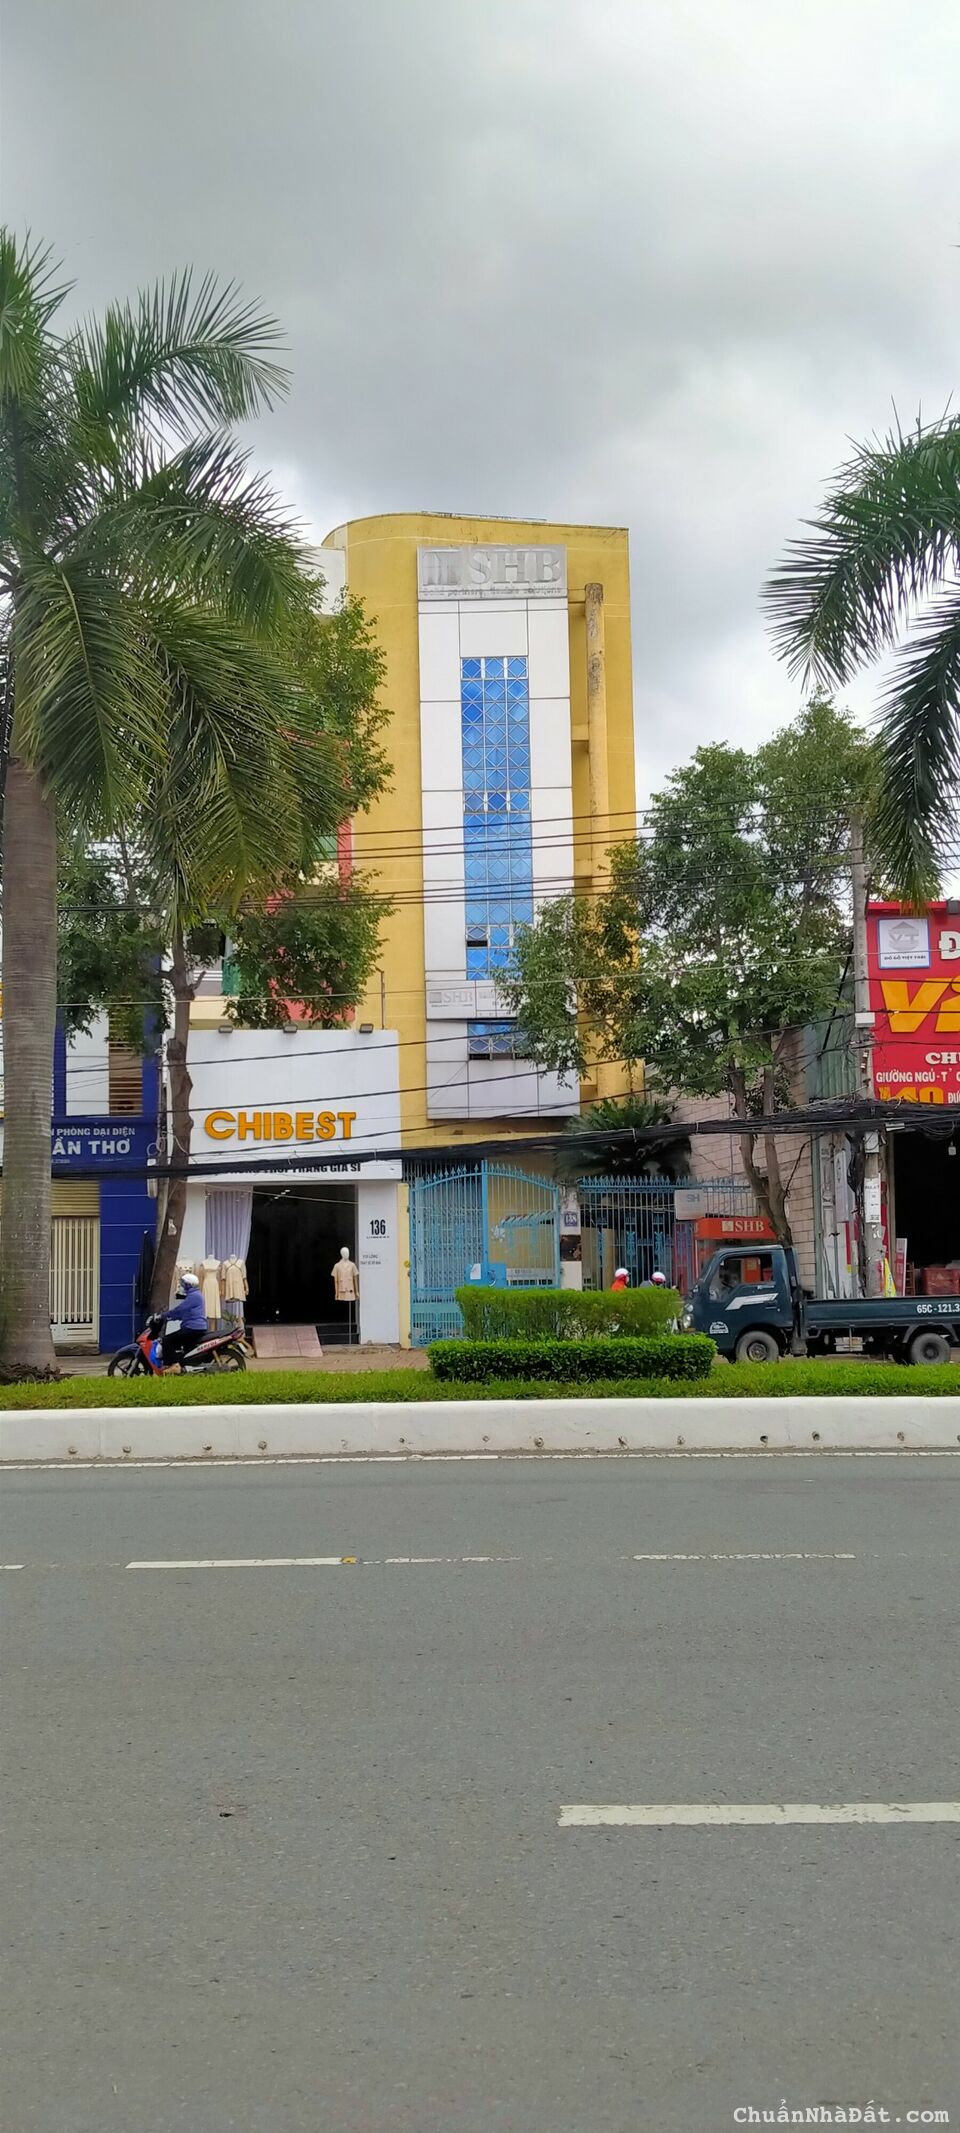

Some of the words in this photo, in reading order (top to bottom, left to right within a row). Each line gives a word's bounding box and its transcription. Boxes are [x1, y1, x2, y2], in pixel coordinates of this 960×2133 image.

[468, 550, 562, 584] SHB
[443, 990, 473, 1003] SHB
[925, 1051, 960, 1065] CH
[876, 1068, 913, 1082] GIƯỜNG
[57, 1125, 91, 1136] PHÒNG
[204, 1111, 357, 1141] CHIBEST
[52, 1136, 81, 1155] ẦN
[88, 1138, 130, 1154] THƠ
[370, 1219, 386, 1235] 136
[735, 1220, 764, 1232] SHB
